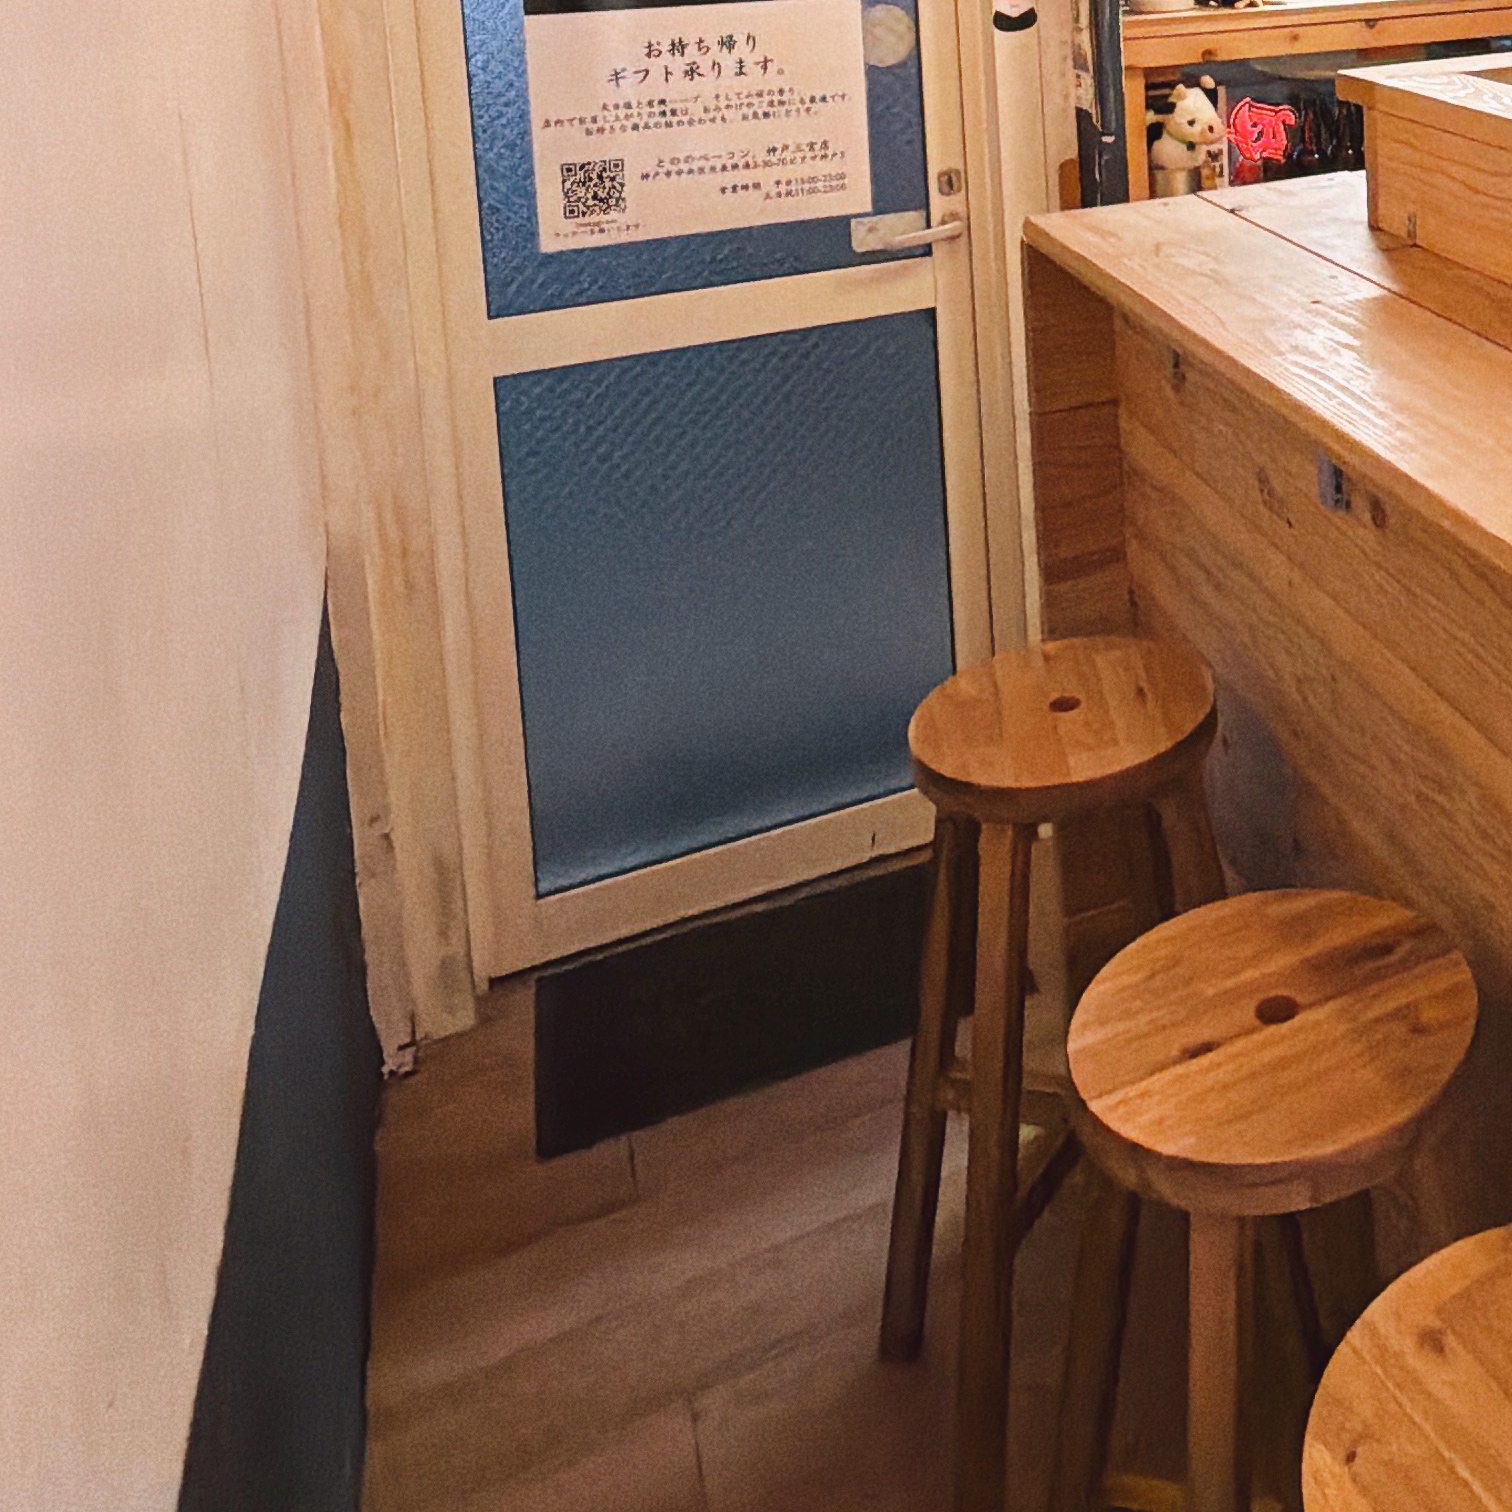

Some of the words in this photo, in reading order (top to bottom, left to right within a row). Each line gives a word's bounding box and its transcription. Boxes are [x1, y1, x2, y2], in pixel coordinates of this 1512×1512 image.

[644, 32, 758, 59] お持ち帰り
[608, 55, 786, 87] ギフト承ります。
